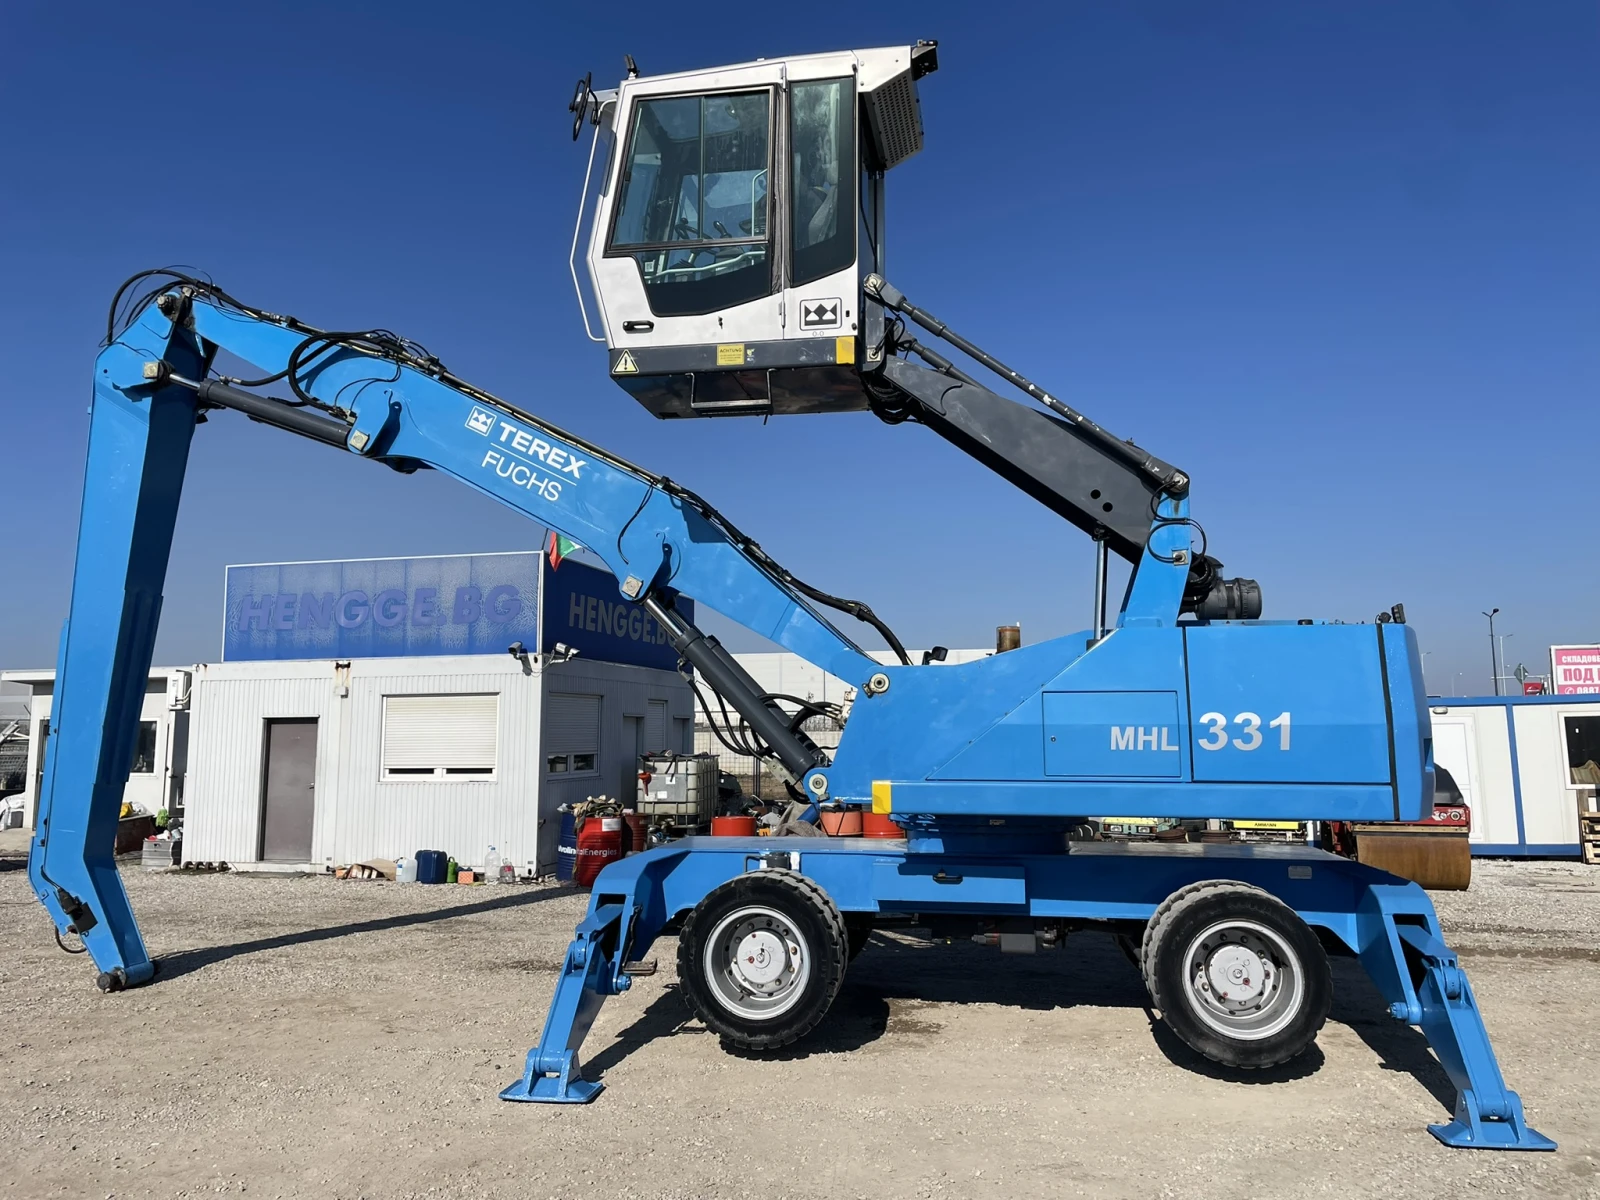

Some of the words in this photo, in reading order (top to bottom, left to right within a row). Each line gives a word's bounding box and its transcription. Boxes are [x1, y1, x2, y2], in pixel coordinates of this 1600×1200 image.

[499, 421, 587, 479] TEREX
[481, 450, 562, 501] FUCHS
[238, 584, 522, 632] HENGGE.BG
[1564, 668, 1594, 683] ПОД
[1110, 726, 1179, 751] MHL
[1197, 711, 1291, 751] 331
